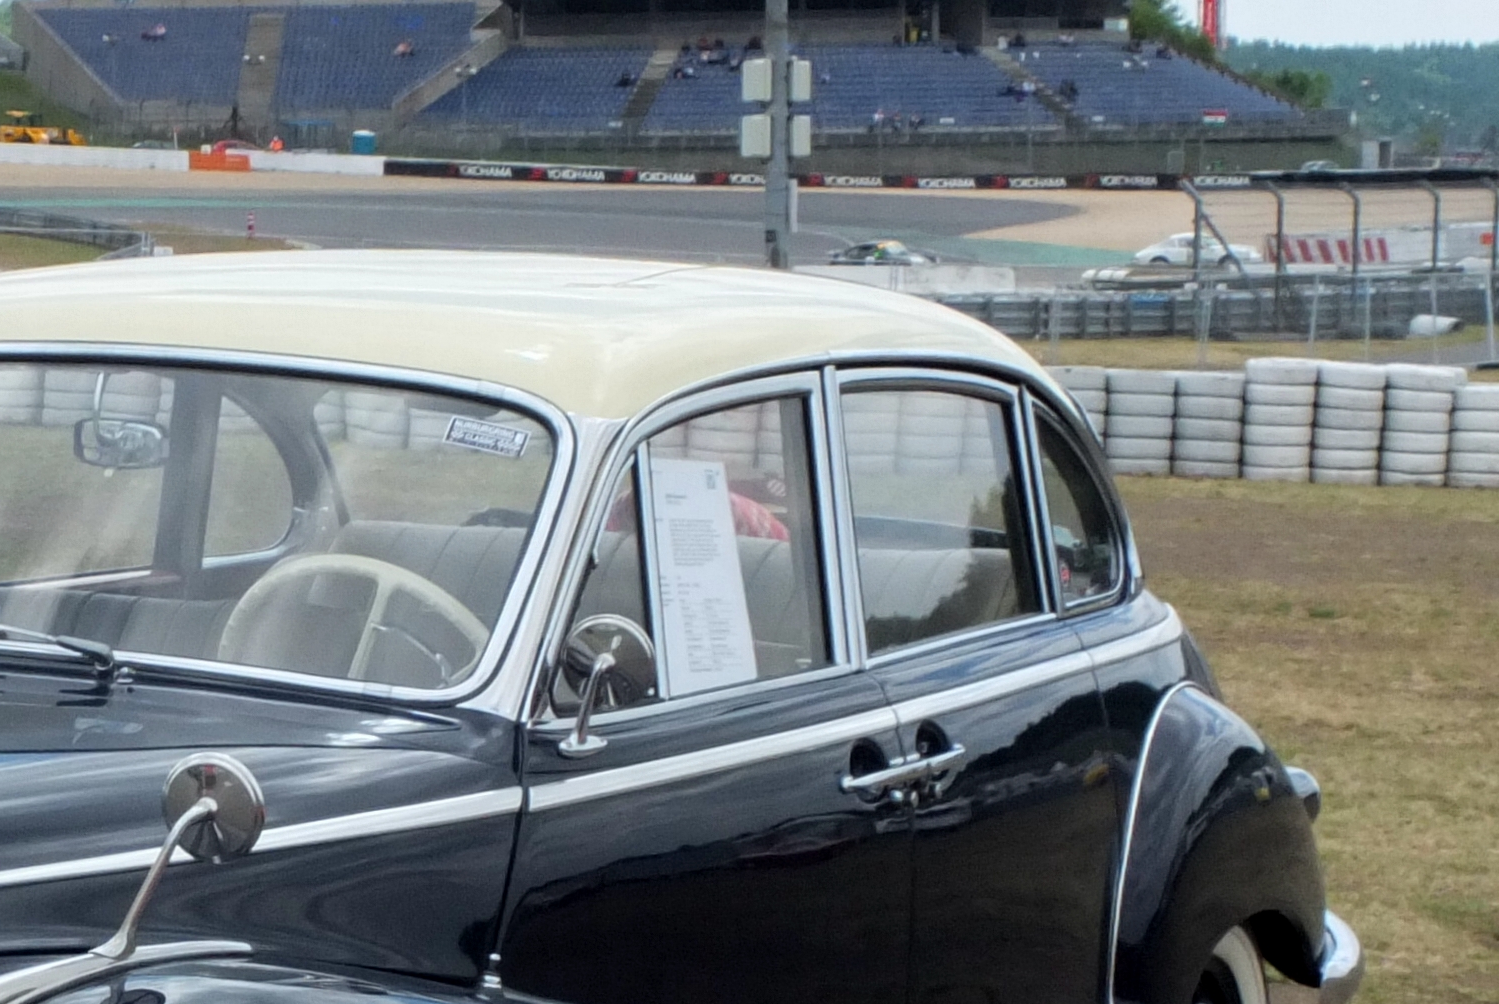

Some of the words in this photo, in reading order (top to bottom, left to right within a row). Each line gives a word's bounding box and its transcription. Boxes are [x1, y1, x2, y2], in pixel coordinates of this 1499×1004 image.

[458, 165, 512, 178] YOKOHAMA
[546, 168, 606, 181] YOKOHAMA
[638, 170, 697, 184] YOKOHAMA
[824, 175, 883, 187] YOKOHAMA
[918, 177, 976, 189] YOKOHAMA
[1008, 177, 1067, 189] YOKOHAMA
